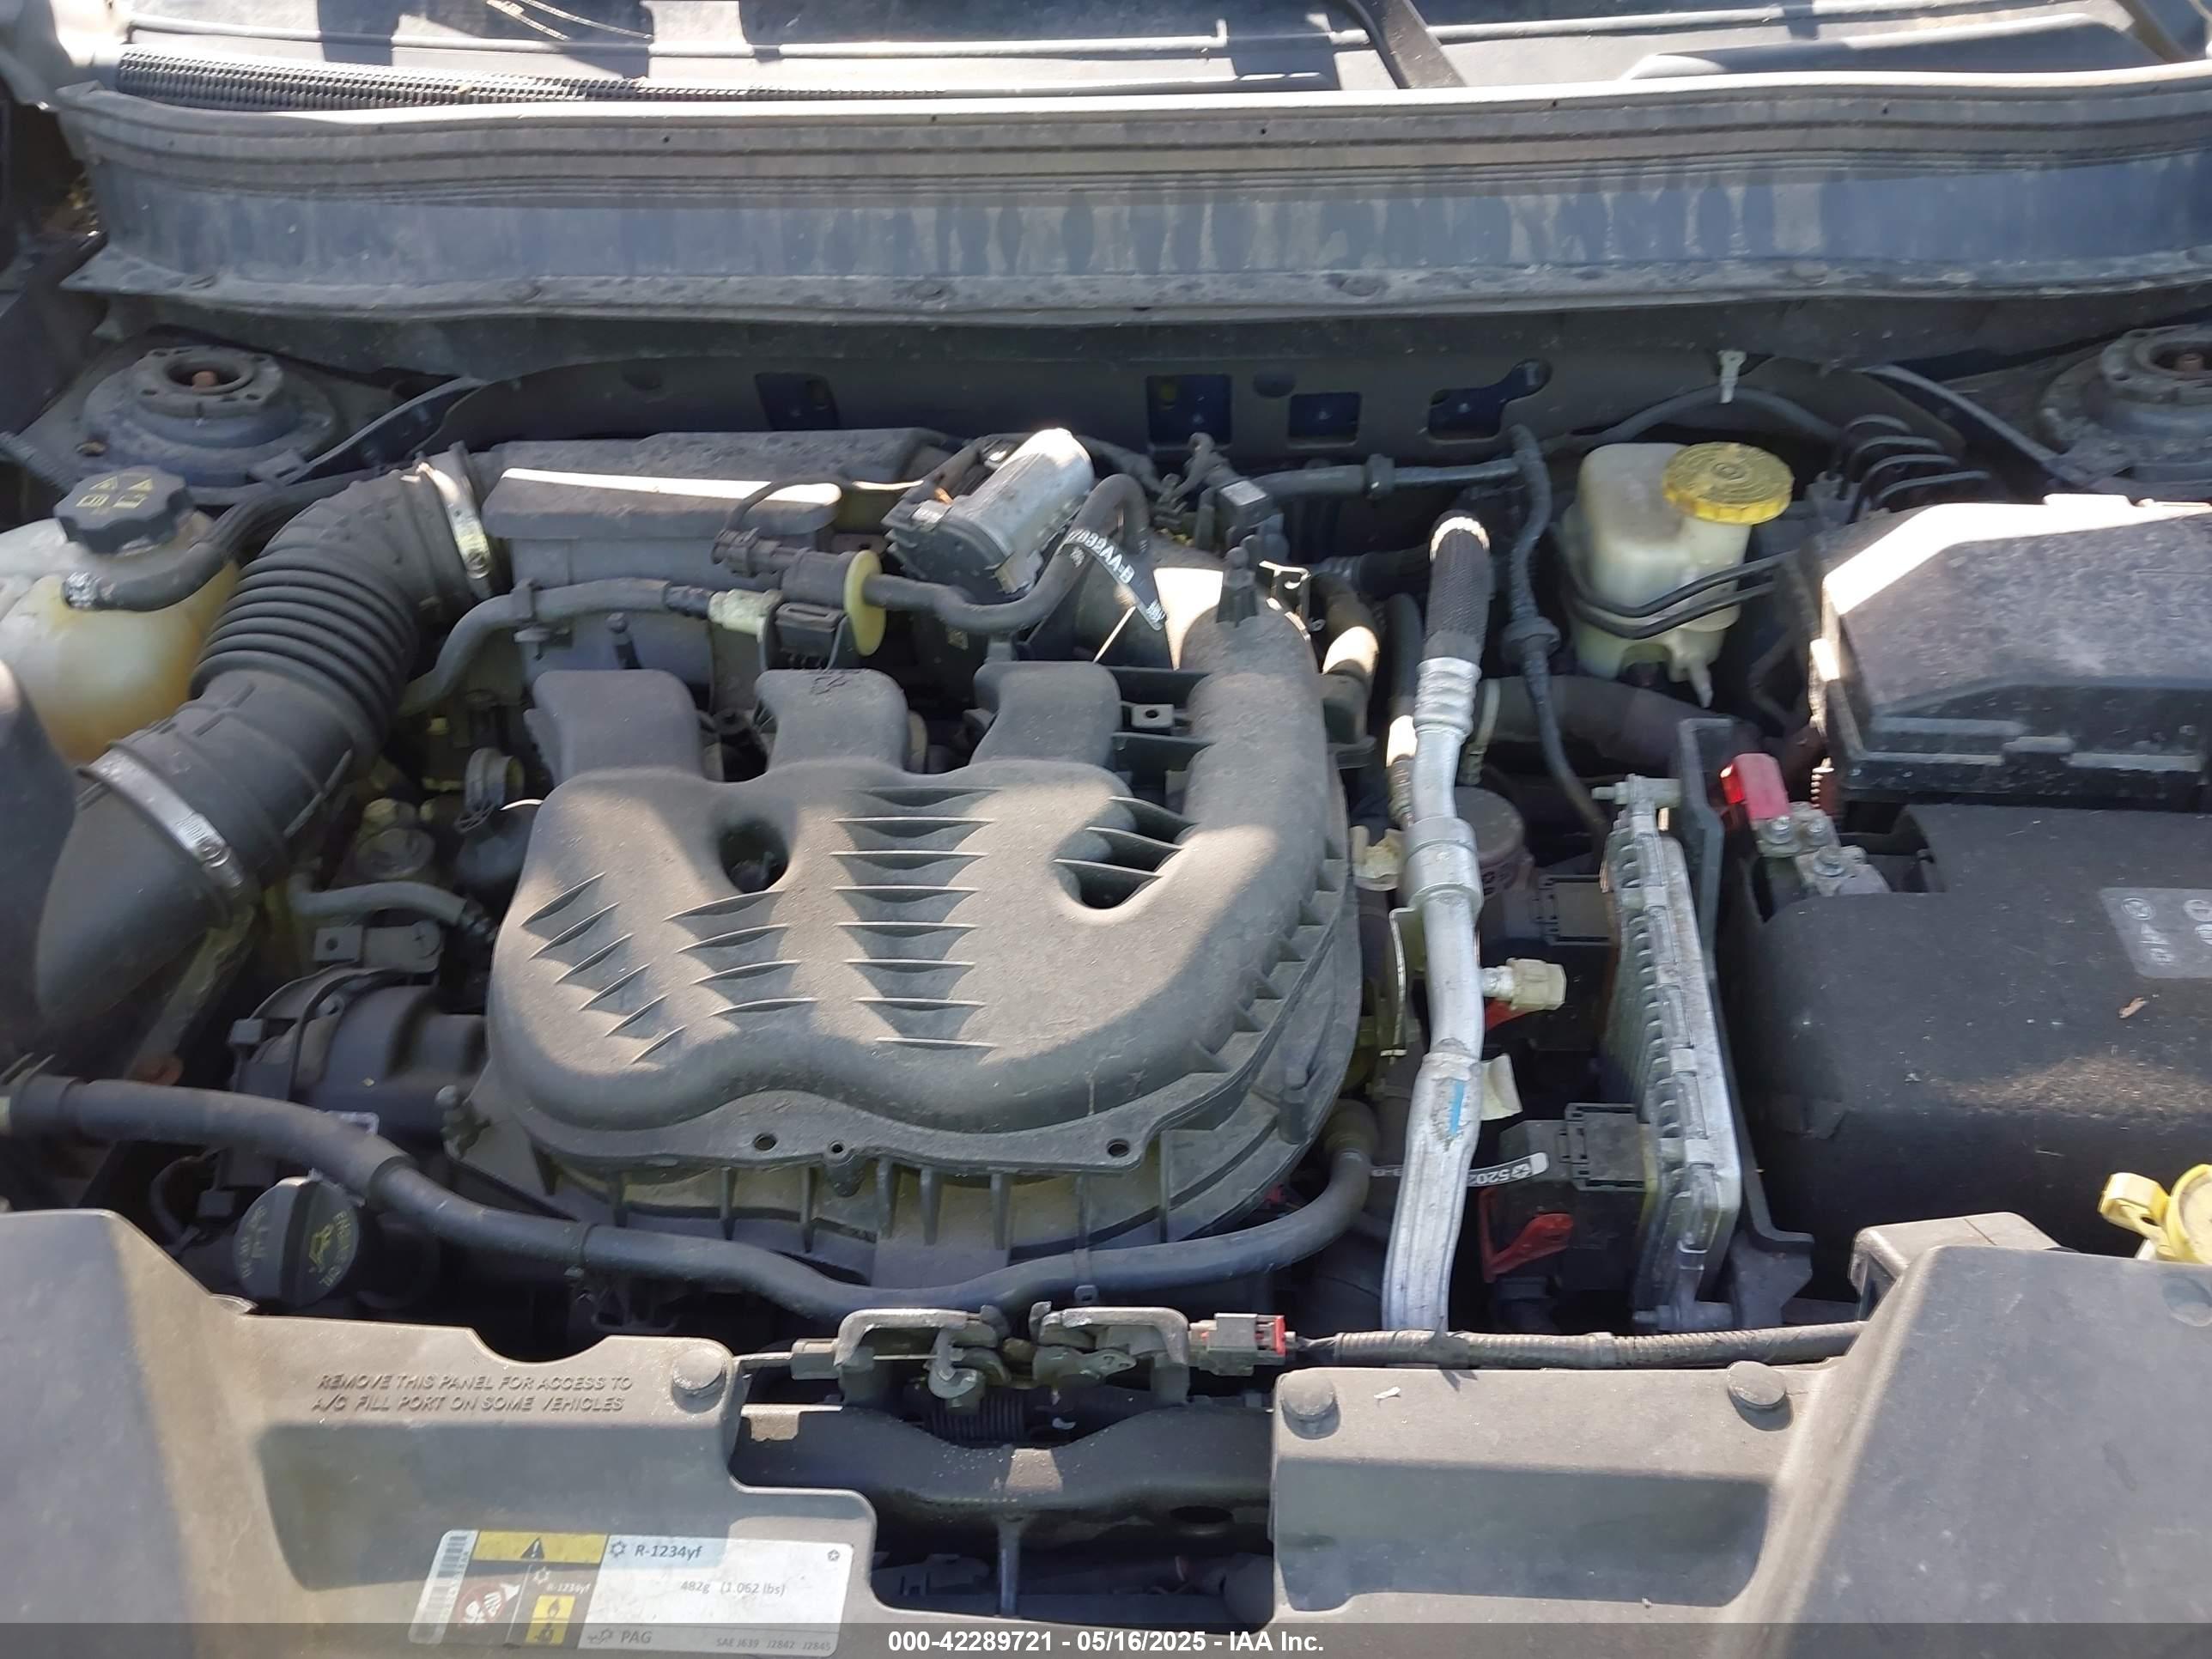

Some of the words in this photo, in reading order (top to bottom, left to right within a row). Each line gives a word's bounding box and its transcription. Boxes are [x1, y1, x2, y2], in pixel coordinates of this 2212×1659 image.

[317, 1374, 392, 1390] REMOVE
[395, 1374, 433, 1390] THIS
[439, 1374, 494, 1390] PANEL
[498, 1374, 534, 1390] FOR
[537, 1374, 605, 1390] ACCESS
[611, 1374, 634, 1390] TO
[311, 1395, 347, 1412] A/C
[355, 1395, 390, 1412] FILL
[397, 1395, 446, 1412] PORT
[450, 1395, 478, 1412] ON
[481, 1395, 534, 1412] SOME
[541, 1395, 625, 1412] VEHICLES
[634, 1546, 701, 1561] R-1234yf
[681, 1581, 710, 1595] 482g
[720, 1581, 759, 1595] (1.062
[763, 1583, 786, 1596] lbs)
[621, 1630, 652, 1645] PAG
[716, 1638, 735, 1648] SAE
